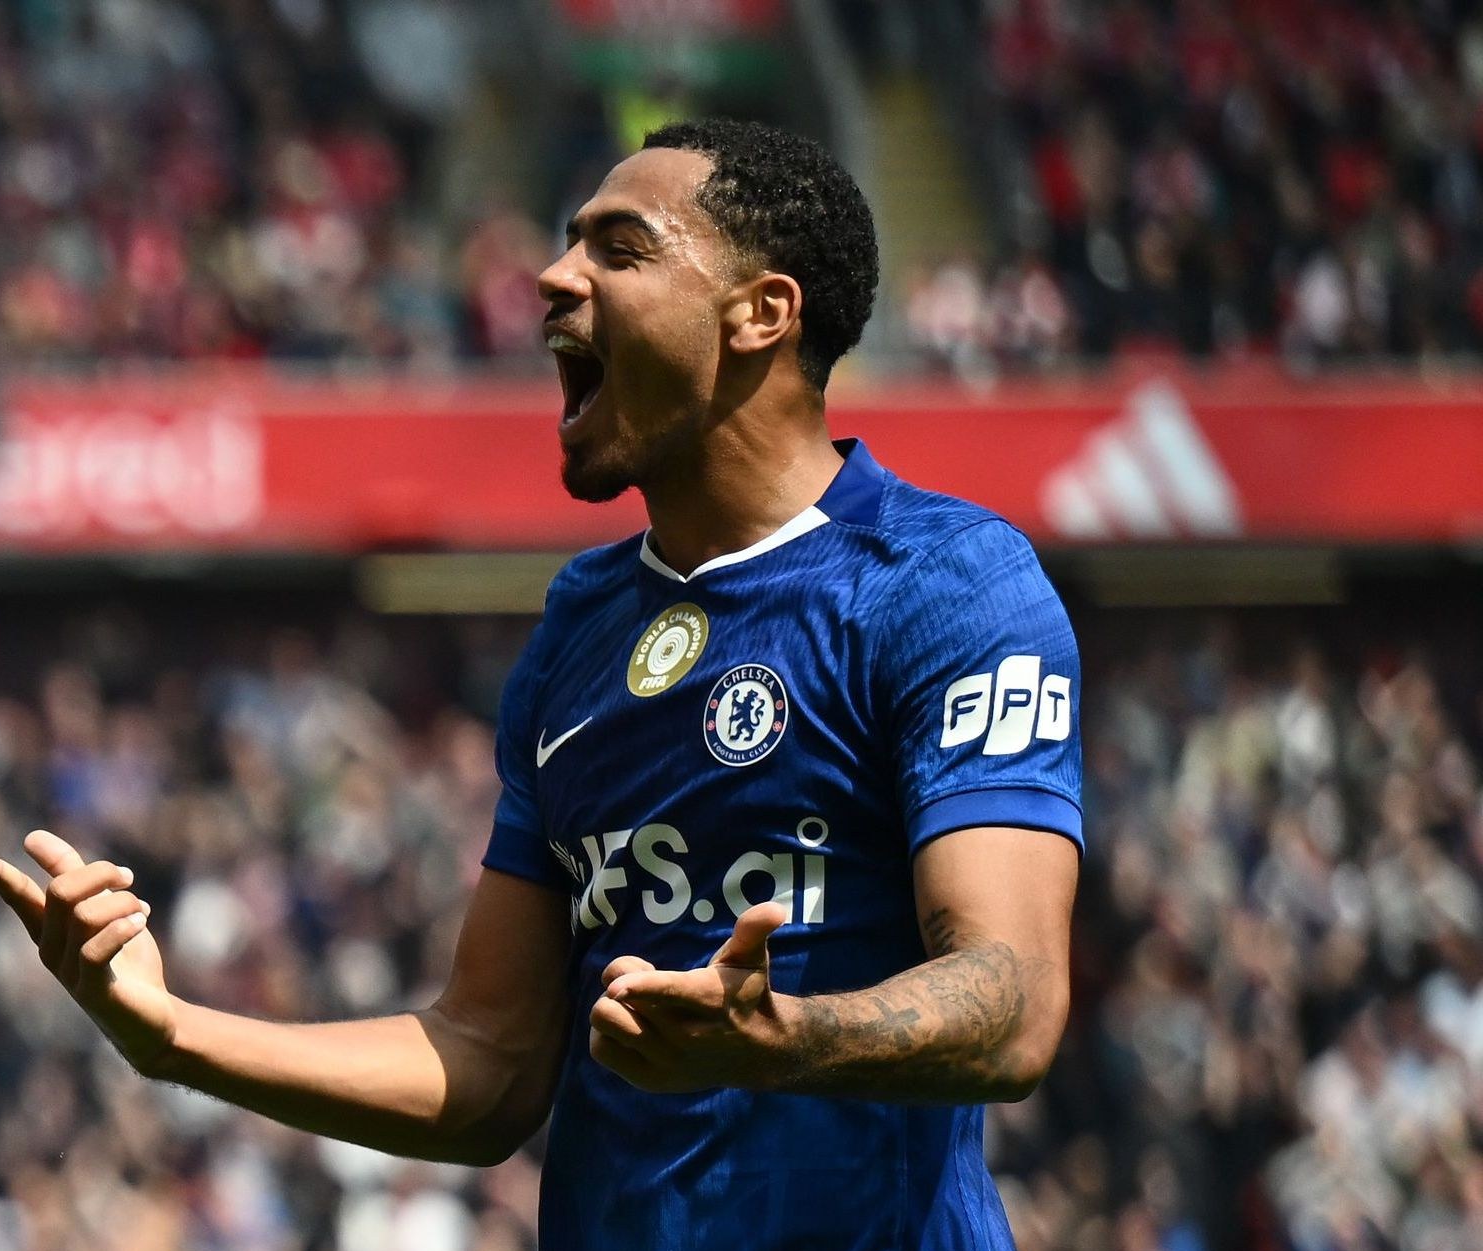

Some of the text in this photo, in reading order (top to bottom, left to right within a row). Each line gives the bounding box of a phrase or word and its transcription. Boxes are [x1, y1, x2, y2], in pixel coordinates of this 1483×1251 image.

[723, 668, 775, 690] CHELSEA
[712, 742, 769, 761] FOOTBALL CLUB
[579, 816, 830, 930] IFS.ai
